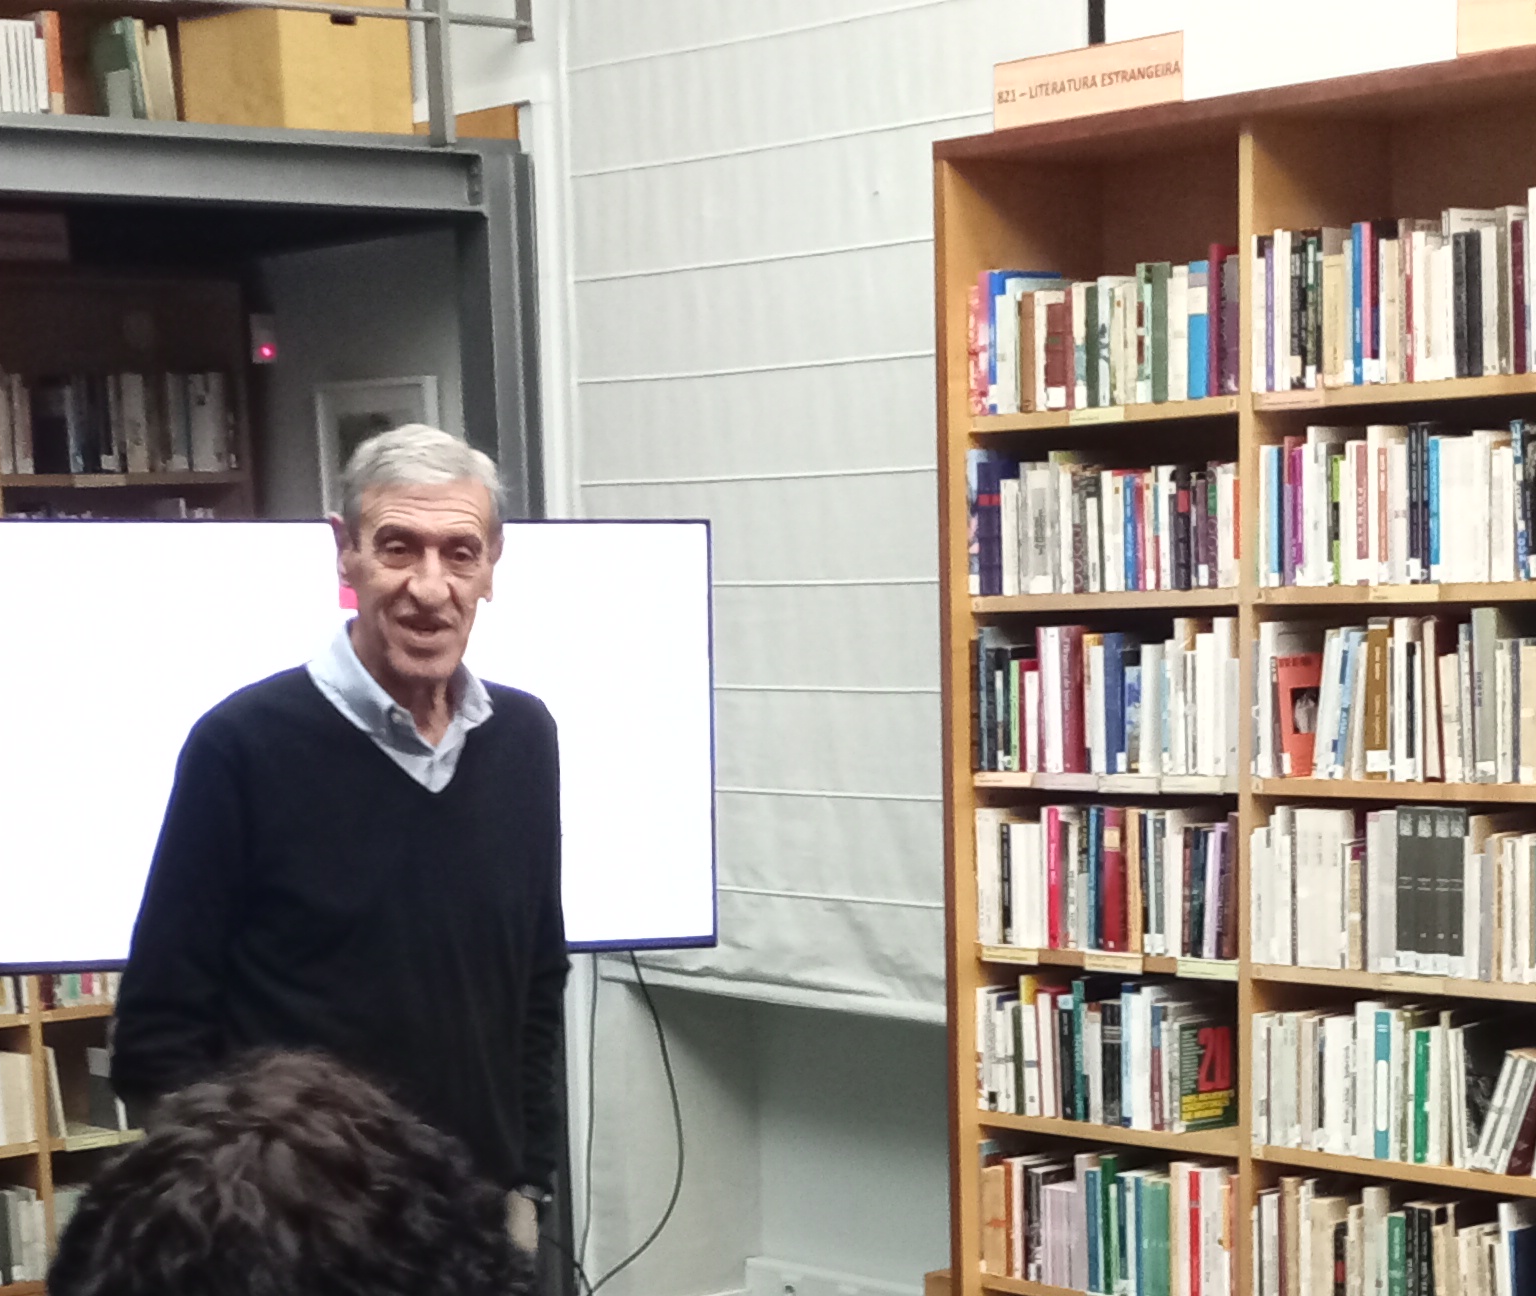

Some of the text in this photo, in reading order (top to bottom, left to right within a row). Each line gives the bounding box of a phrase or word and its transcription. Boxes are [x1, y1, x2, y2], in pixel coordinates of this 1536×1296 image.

[997, 89, 1016, 104] 821
[1028, 75, 1098, 99] LITERATURA
[1101, 60, 1181, 87] ESTRANGEIRA
